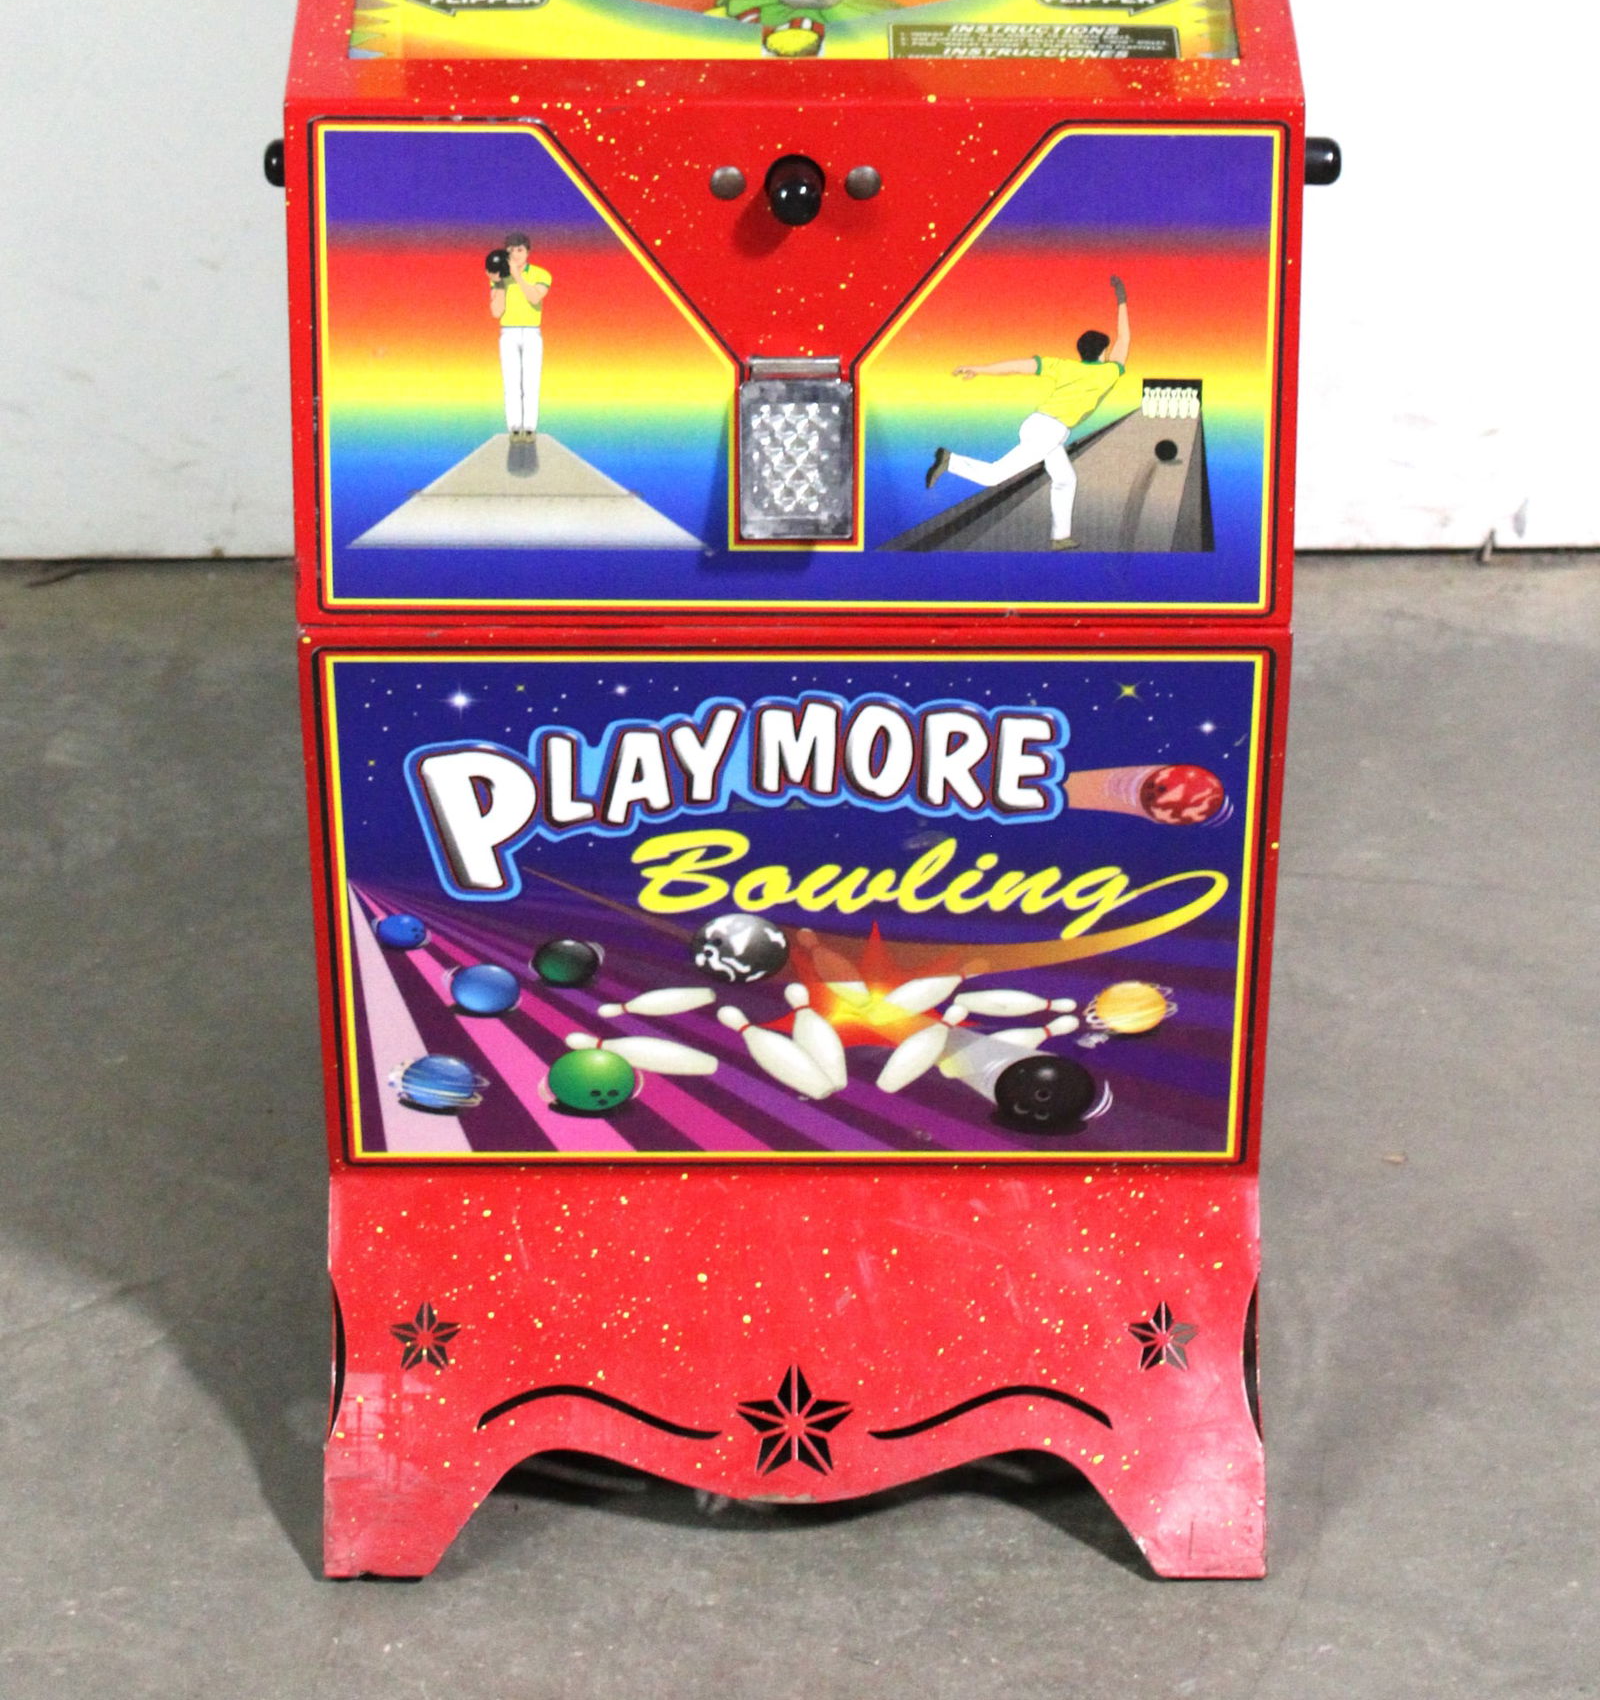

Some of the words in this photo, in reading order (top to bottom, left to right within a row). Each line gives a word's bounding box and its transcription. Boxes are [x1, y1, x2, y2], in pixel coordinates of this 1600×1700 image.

[942, 46, 1131, 59] INSTRUCCIONES
[950, 23, 1121, 36] INSTRUCTIONS
[419, 704, 740, 892] PLAY
[752, 700, 1057, 813] MORE
[629, 829, 1228, 940] Bowling
